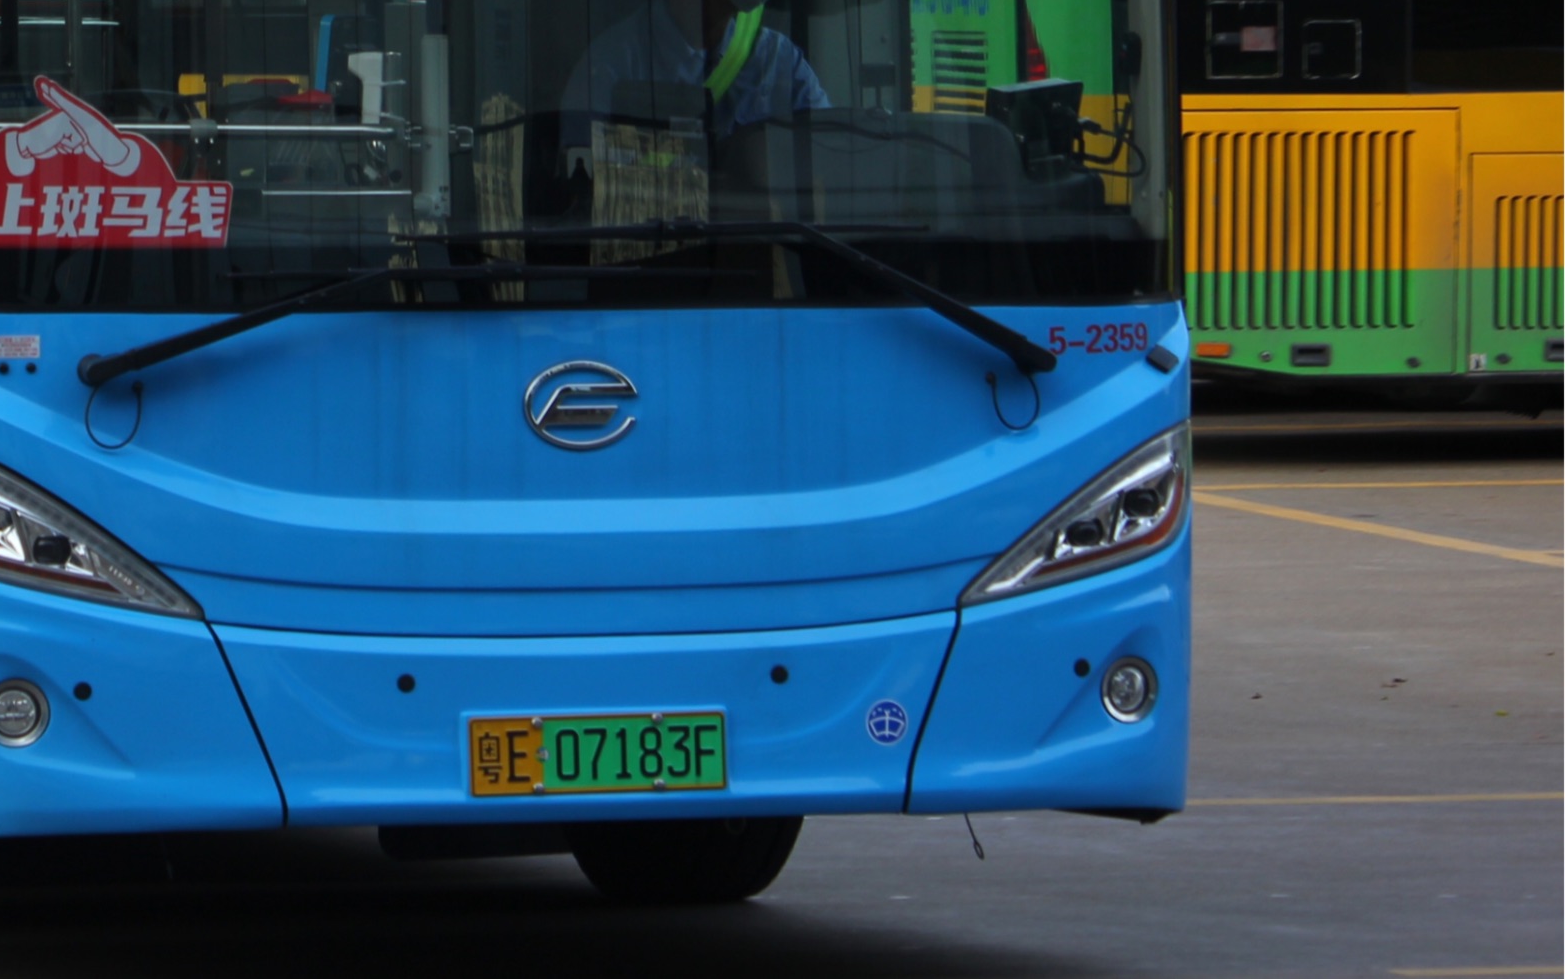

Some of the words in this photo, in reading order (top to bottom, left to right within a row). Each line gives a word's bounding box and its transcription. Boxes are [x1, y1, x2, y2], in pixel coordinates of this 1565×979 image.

[1048, 322, 1149, 356] 5-2359
[478, 730, 532, 785] 粤E
[555, 724, 718, 782] 07183F
